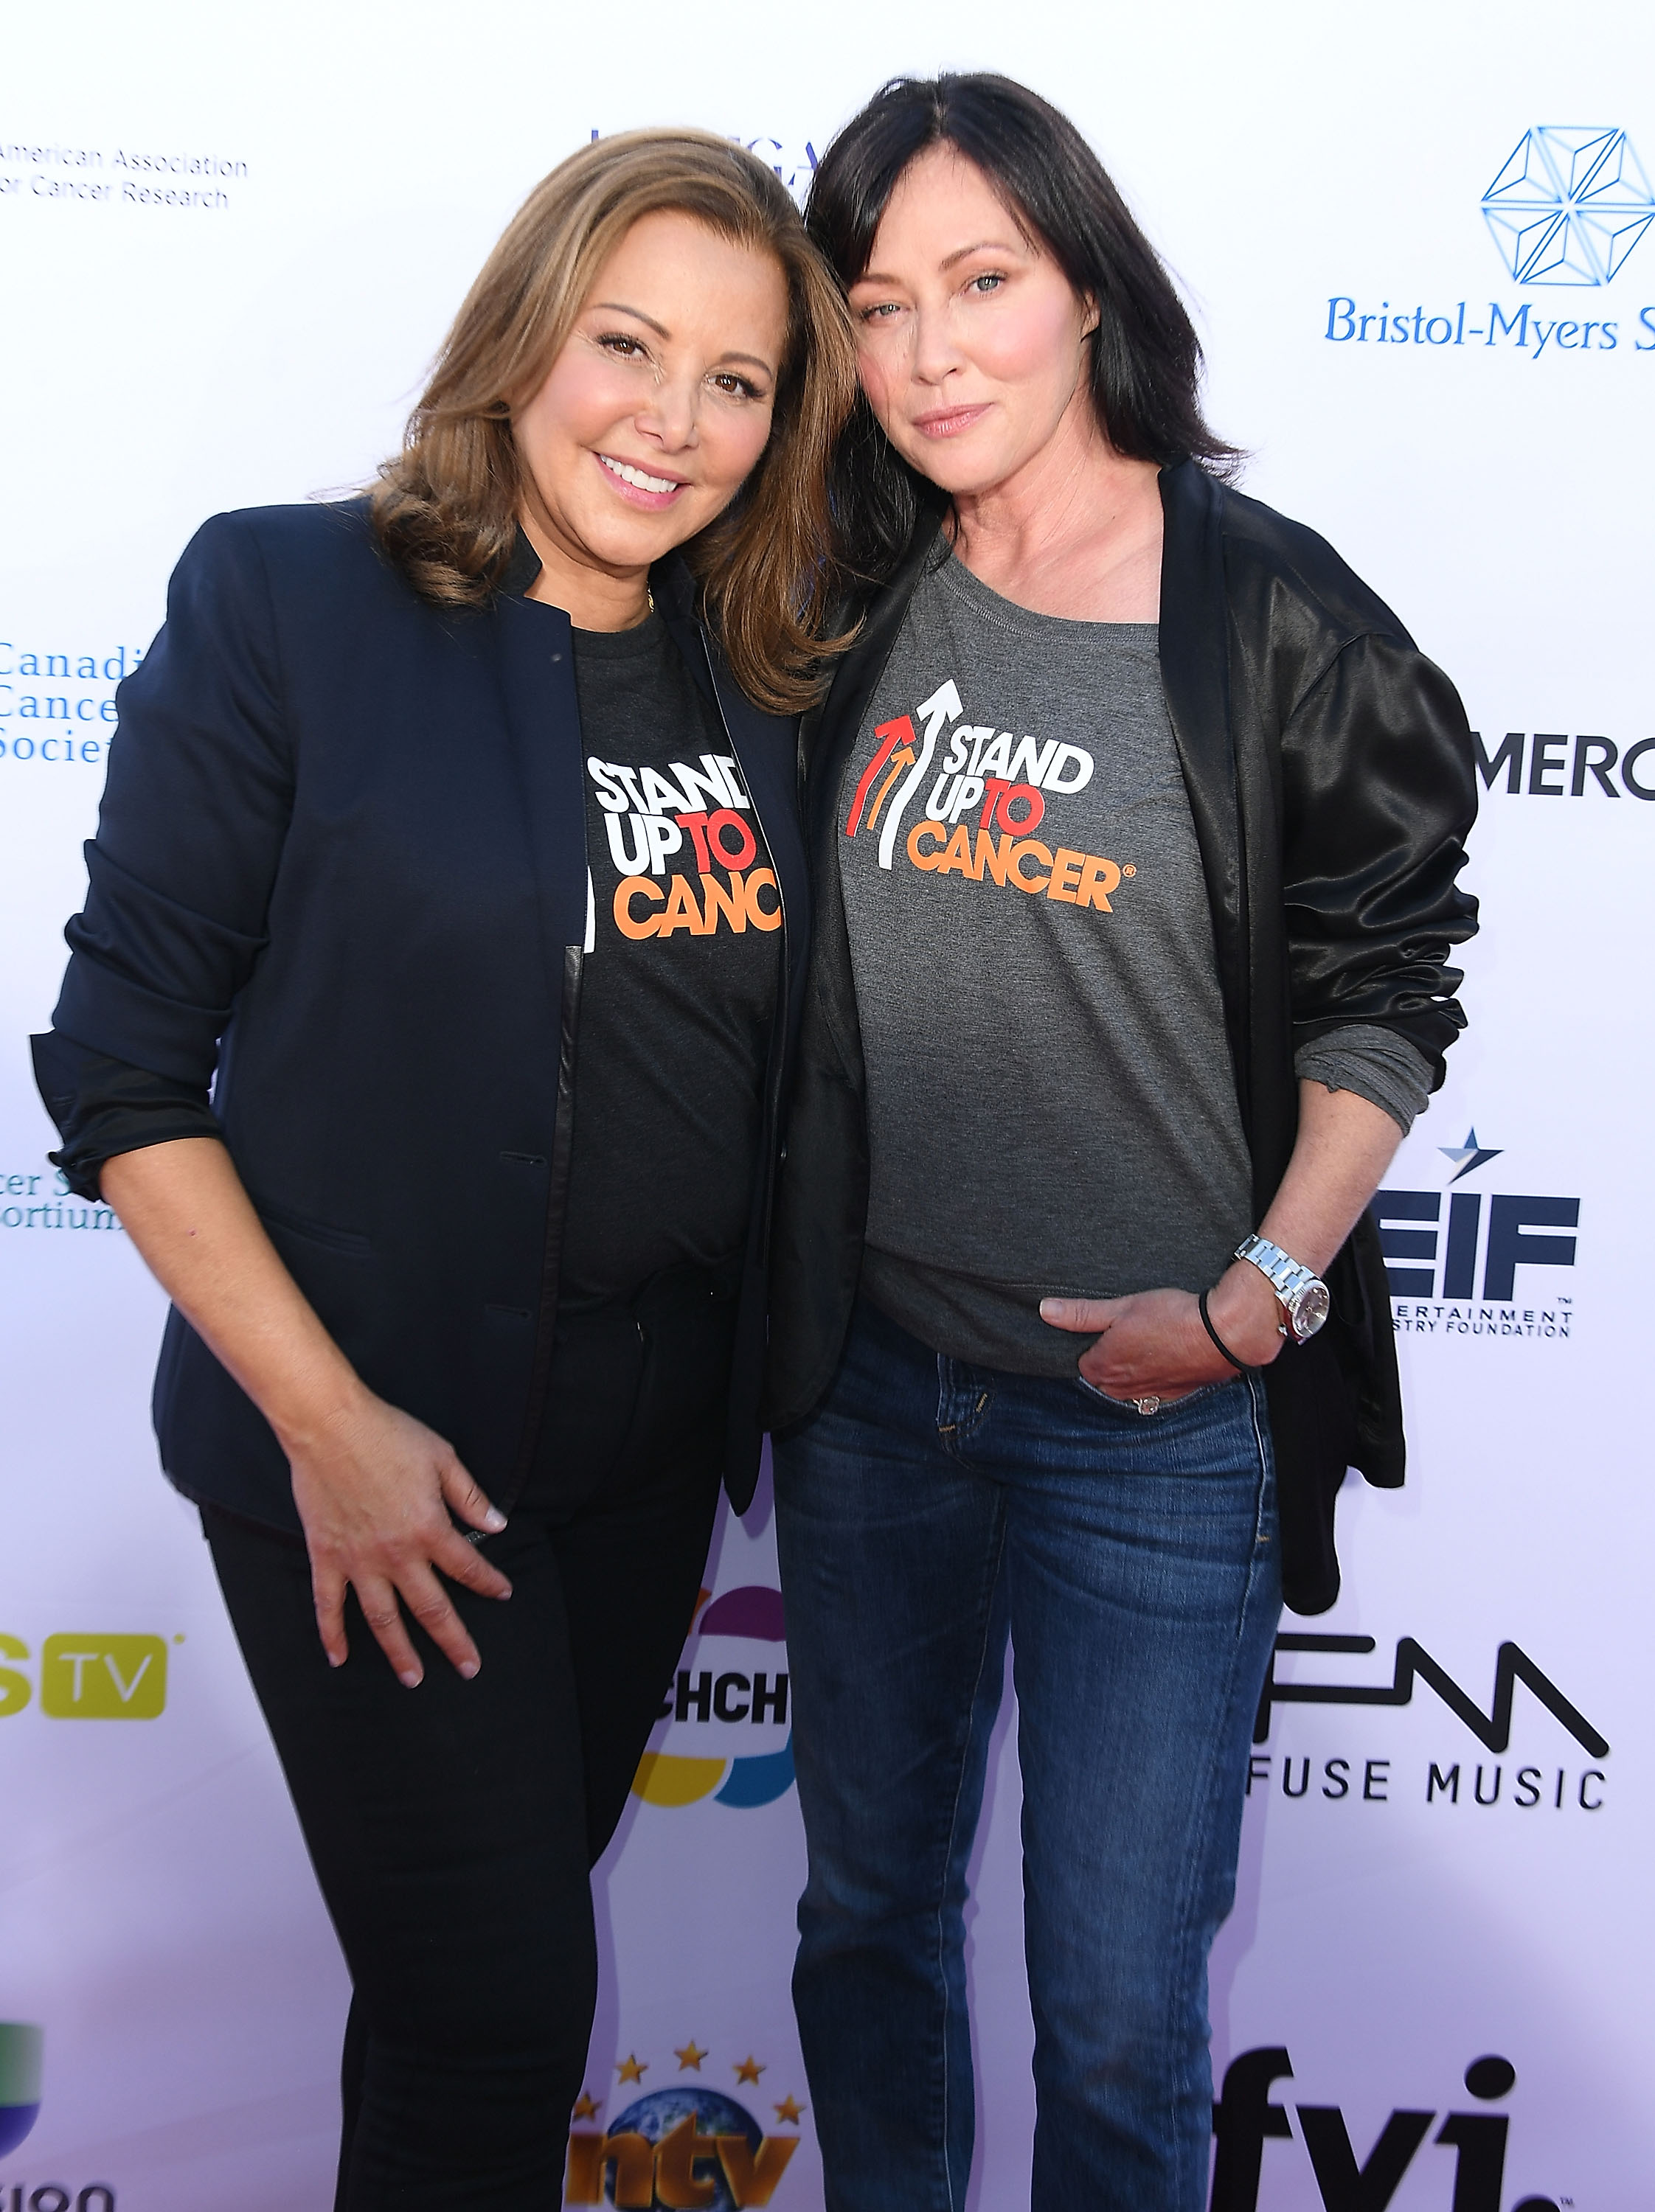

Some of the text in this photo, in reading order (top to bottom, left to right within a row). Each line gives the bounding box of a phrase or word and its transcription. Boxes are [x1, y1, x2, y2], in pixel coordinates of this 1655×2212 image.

[30, 174, 112, 201] Cancer
[122, 181, 229, 209] Research
[114, 149, 248, 178] Association
[1325, 296, 1619, 360] Bristol-Myers
[943, 725, 1094, 794] STAND
[926, 773, 1045, 837] UP TO
[603, 808, 757, 877] UP TO
[613, 868, 782, 940] CANC
[1376, 1189, 1581, 1302] EIF
[1397, 1305, 1573, 1324] ERTAINMENT
[1446, 1321, 1571, 1338] FOUNDATION
[58, 1652, 153, 1703] TV
[1244, 1756, 1606, 1810] FUSE MUSIC
[566, 2107, 801, 2209] ntv
